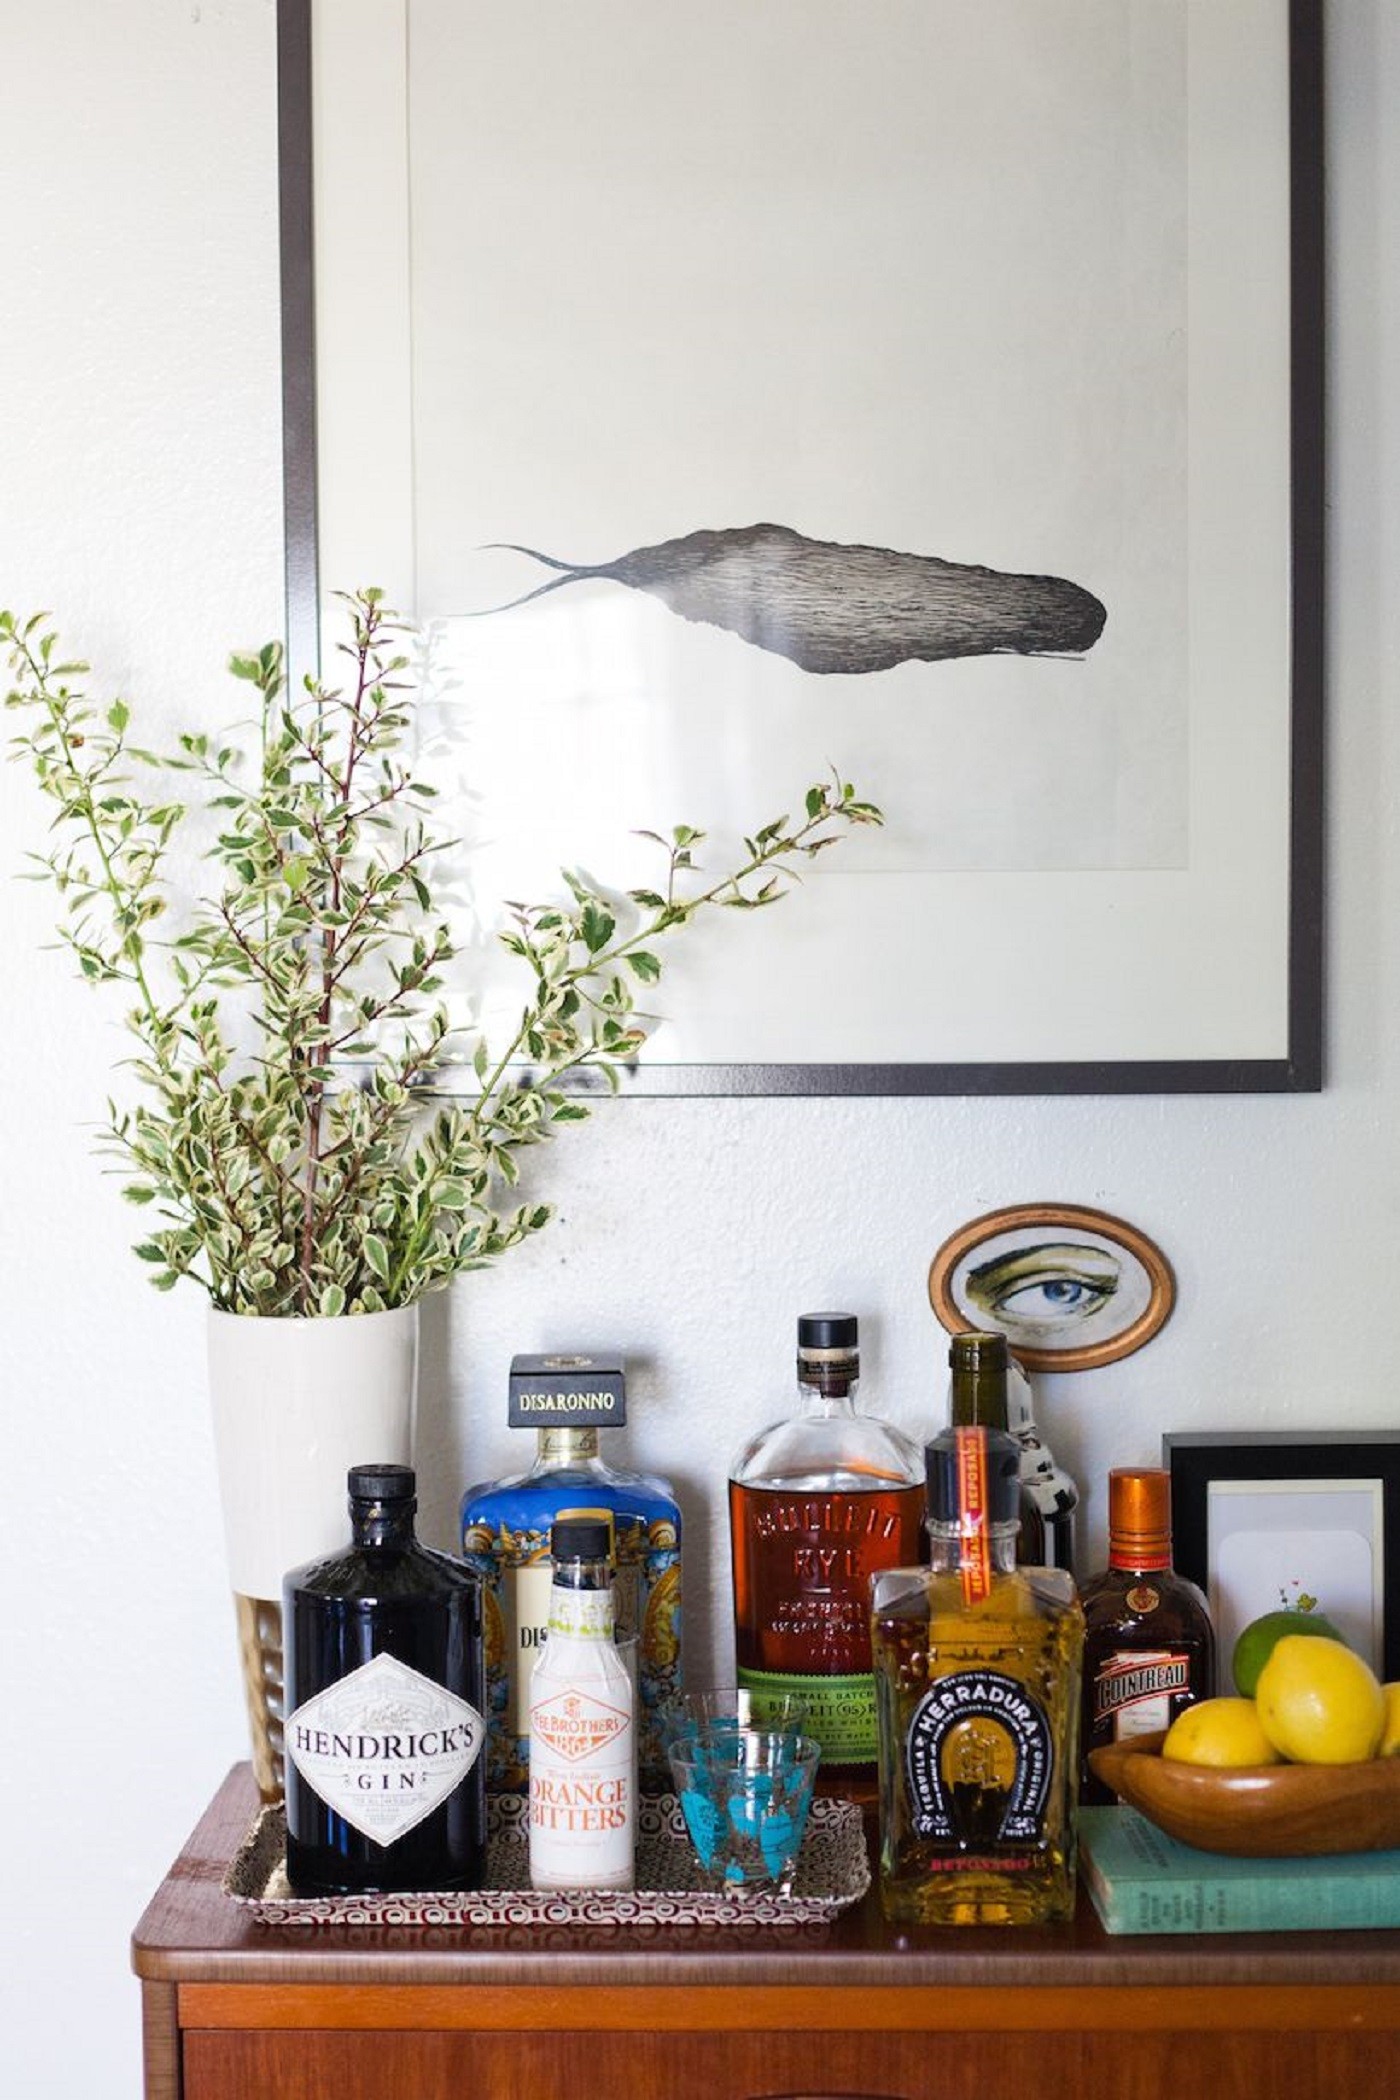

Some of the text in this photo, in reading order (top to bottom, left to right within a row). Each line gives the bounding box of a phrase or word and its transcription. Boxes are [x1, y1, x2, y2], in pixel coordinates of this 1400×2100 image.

[520, 1392, 616, 1412] DISARONNO
[794, 1549, 860, 1577] RYE
[1099, 1663, 1187, 1710] COINTREAU
[550, 1714, 620, 1733] BROTHERS
[918, 1683, 1040, 1736] HERRADURA
[296, 1722, 475, 1760] HENDRICK'S
[357, 1773, 416, 1790] GIN
[531, 1776, 628, 1806] ORANGE
[914, 1751, 933, 1812] TEQUILA
[1023, 1751, 1044, 1812] ORIGINAL
[532, 1803, 627, 1831] BITTERS
